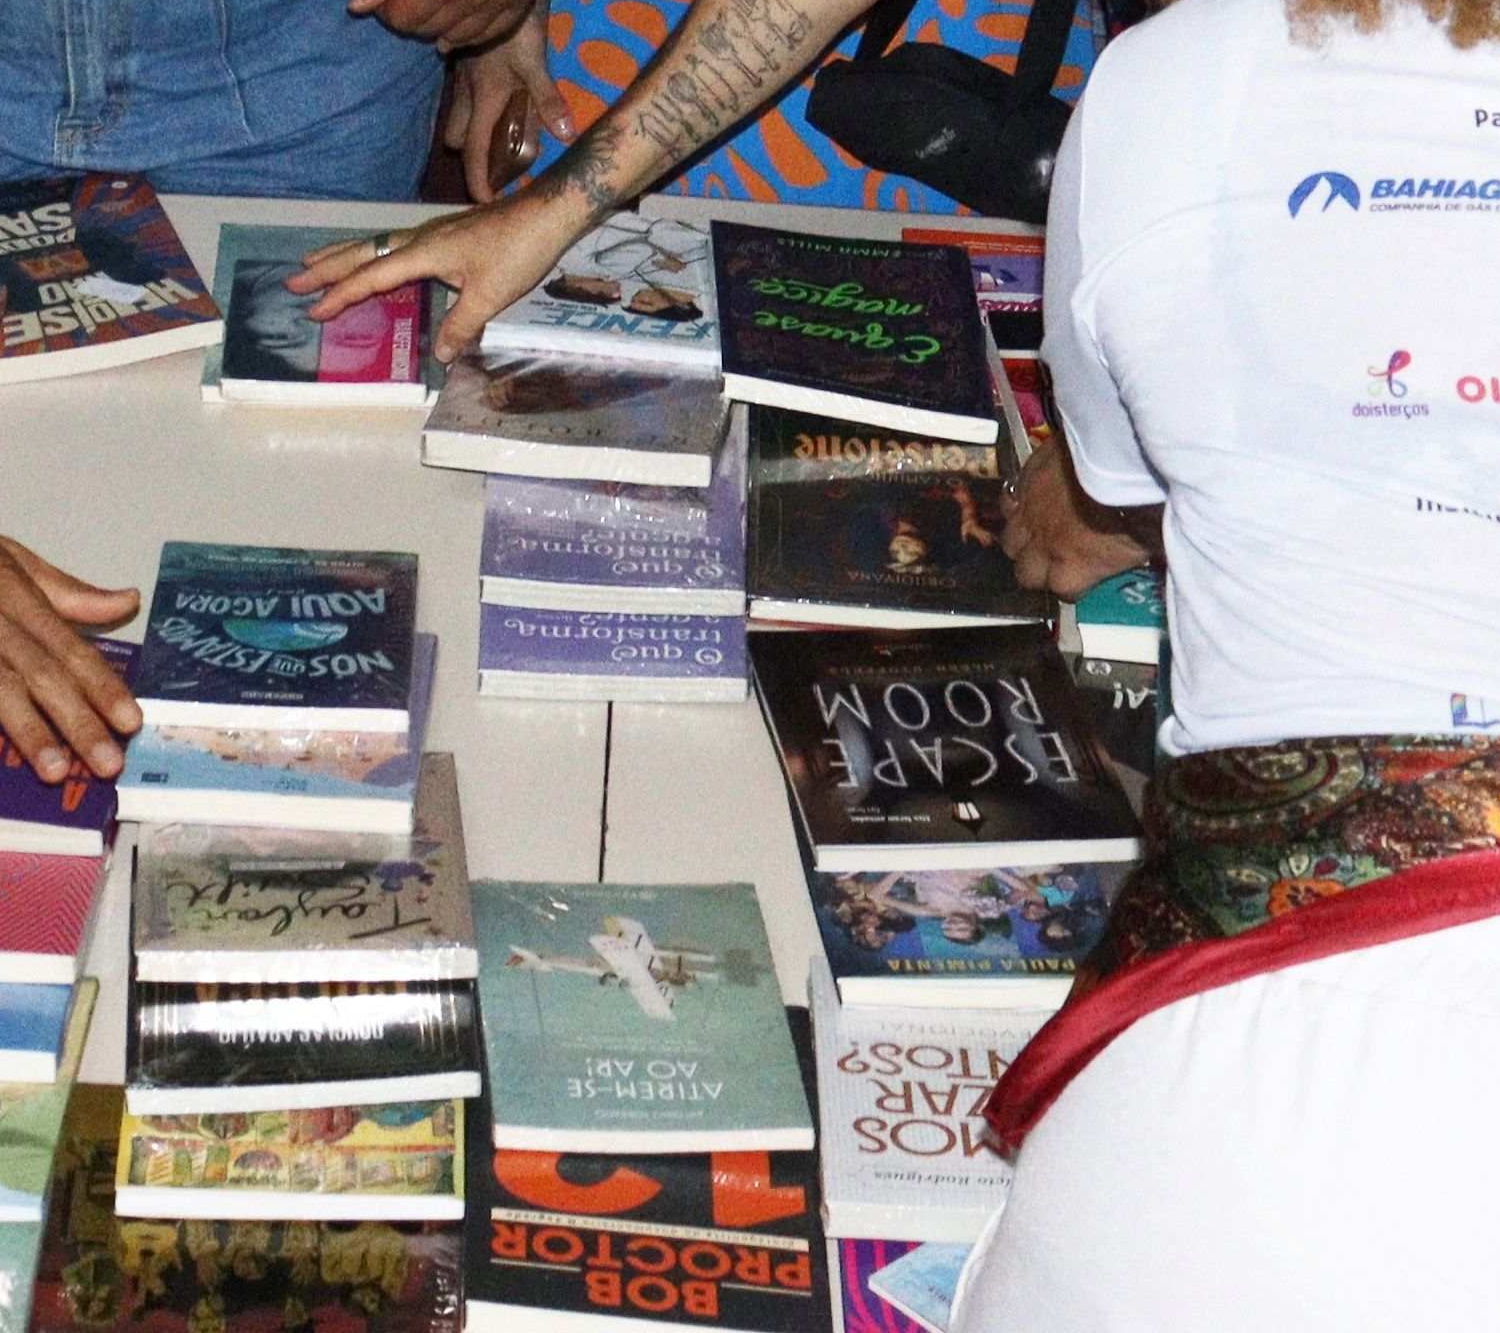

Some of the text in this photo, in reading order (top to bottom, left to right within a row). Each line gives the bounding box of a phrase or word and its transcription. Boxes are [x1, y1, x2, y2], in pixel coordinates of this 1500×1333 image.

[529, 309, 716, 340] FENCE
[752, 311, 895, 350] quase
[516, 535, 722, 563] transforma
[611, 560, 684, 576] que
[175, 587, 386, 619] AQUI AGORA
[157, 615, 273, 673] ESTAMOS
[504, 620, 722, 644] transforma
[307, 649, 394, 680] NÓS
[611, 645, 684, 662] que
[812, 676, 1045, 731] ROOM
[821, 731, 1079, 788] ESCAPE
[205, 891, 432, 940] Taylor
[584, 1057, 699, 1080] AO AR!
[567, 1078, 725, 1102] ATIREM-SE
[490, 1224, 812, 1289] PROCTOR
[585, 1270, 720, 1319] BOB
